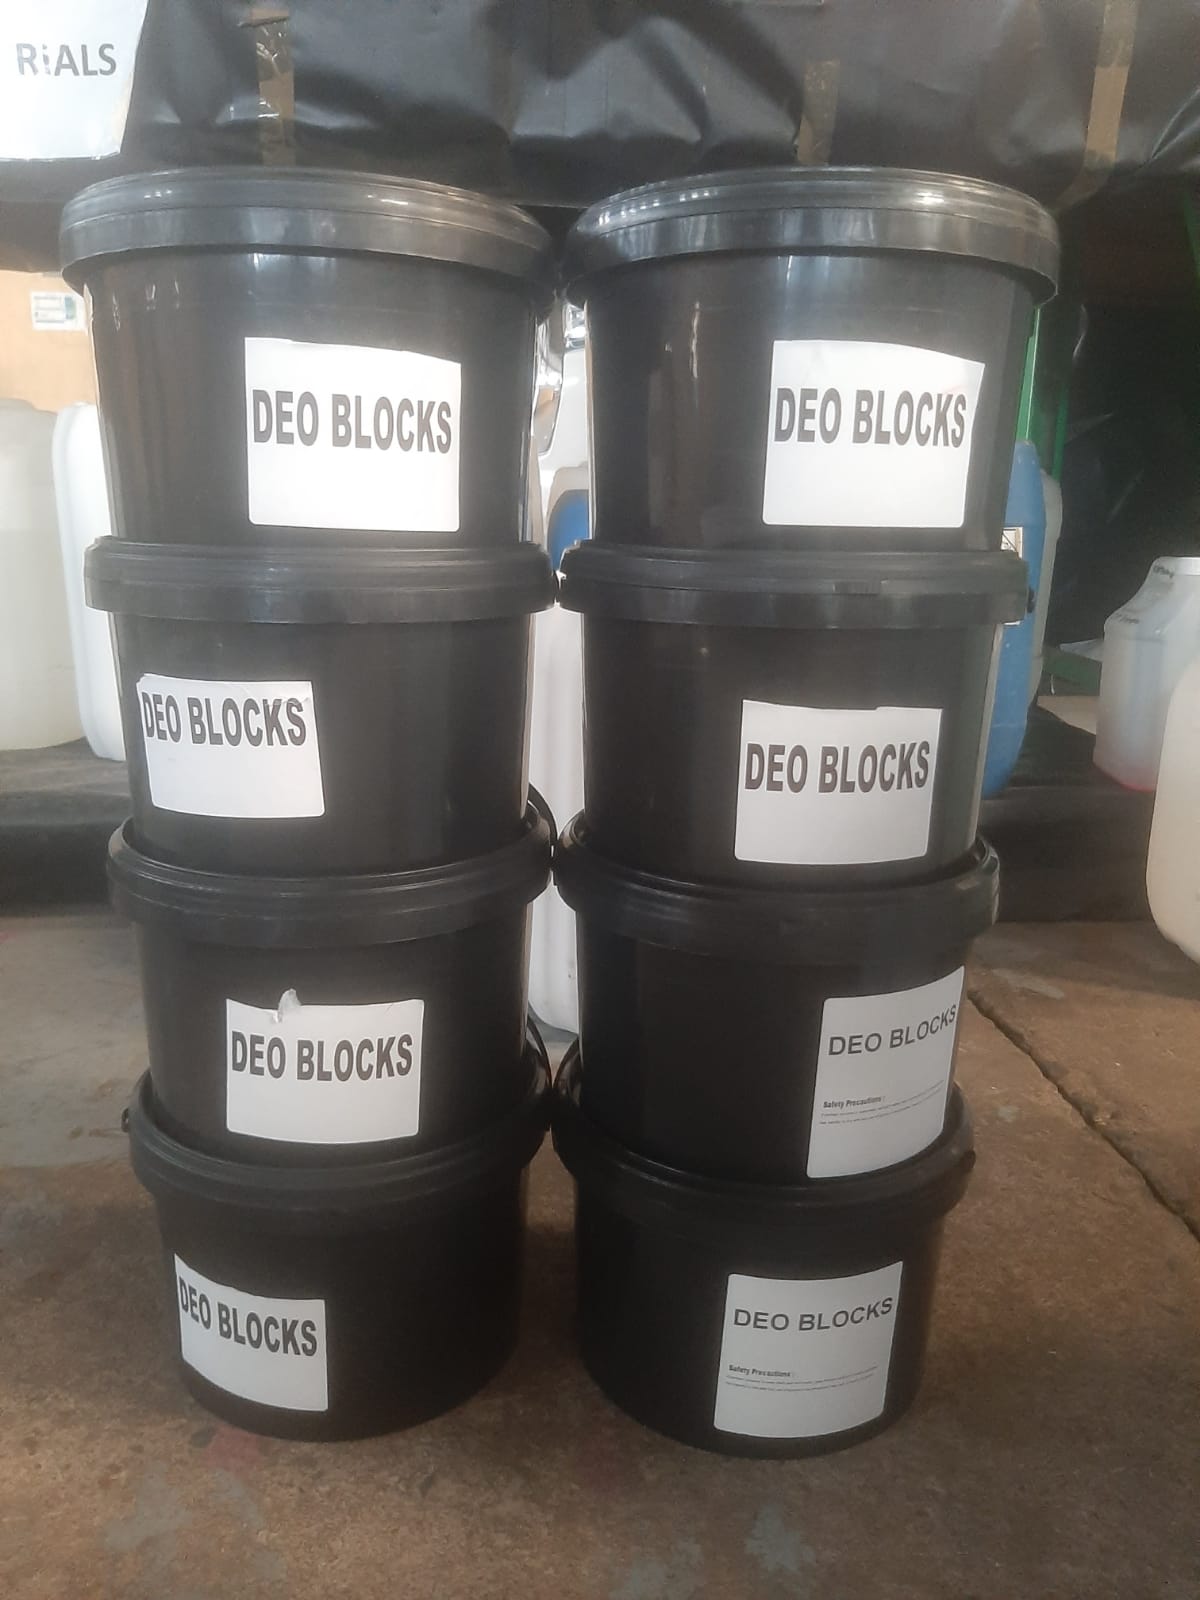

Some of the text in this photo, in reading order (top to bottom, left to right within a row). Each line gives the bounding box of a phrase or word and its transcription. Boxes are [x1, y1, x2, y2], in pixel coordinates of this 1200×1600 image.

[252, 388, 452, 455] DEO BLOCKS
[773, 387, 967, 449] DEO BLOCKS
[141, 691, 307, 747] DEO BLOCKS
[744, 740, 931, 794] DEO BLOCKS
[231, 1030, 413, 1082] DEO BLOCKS
[828, 1003, 957, 1056] DEO BLOCKS
[178, 1275, 318, 1357] DEO BLOCKS
[733, 1296, 895, 1331] DEO BLOCKS
